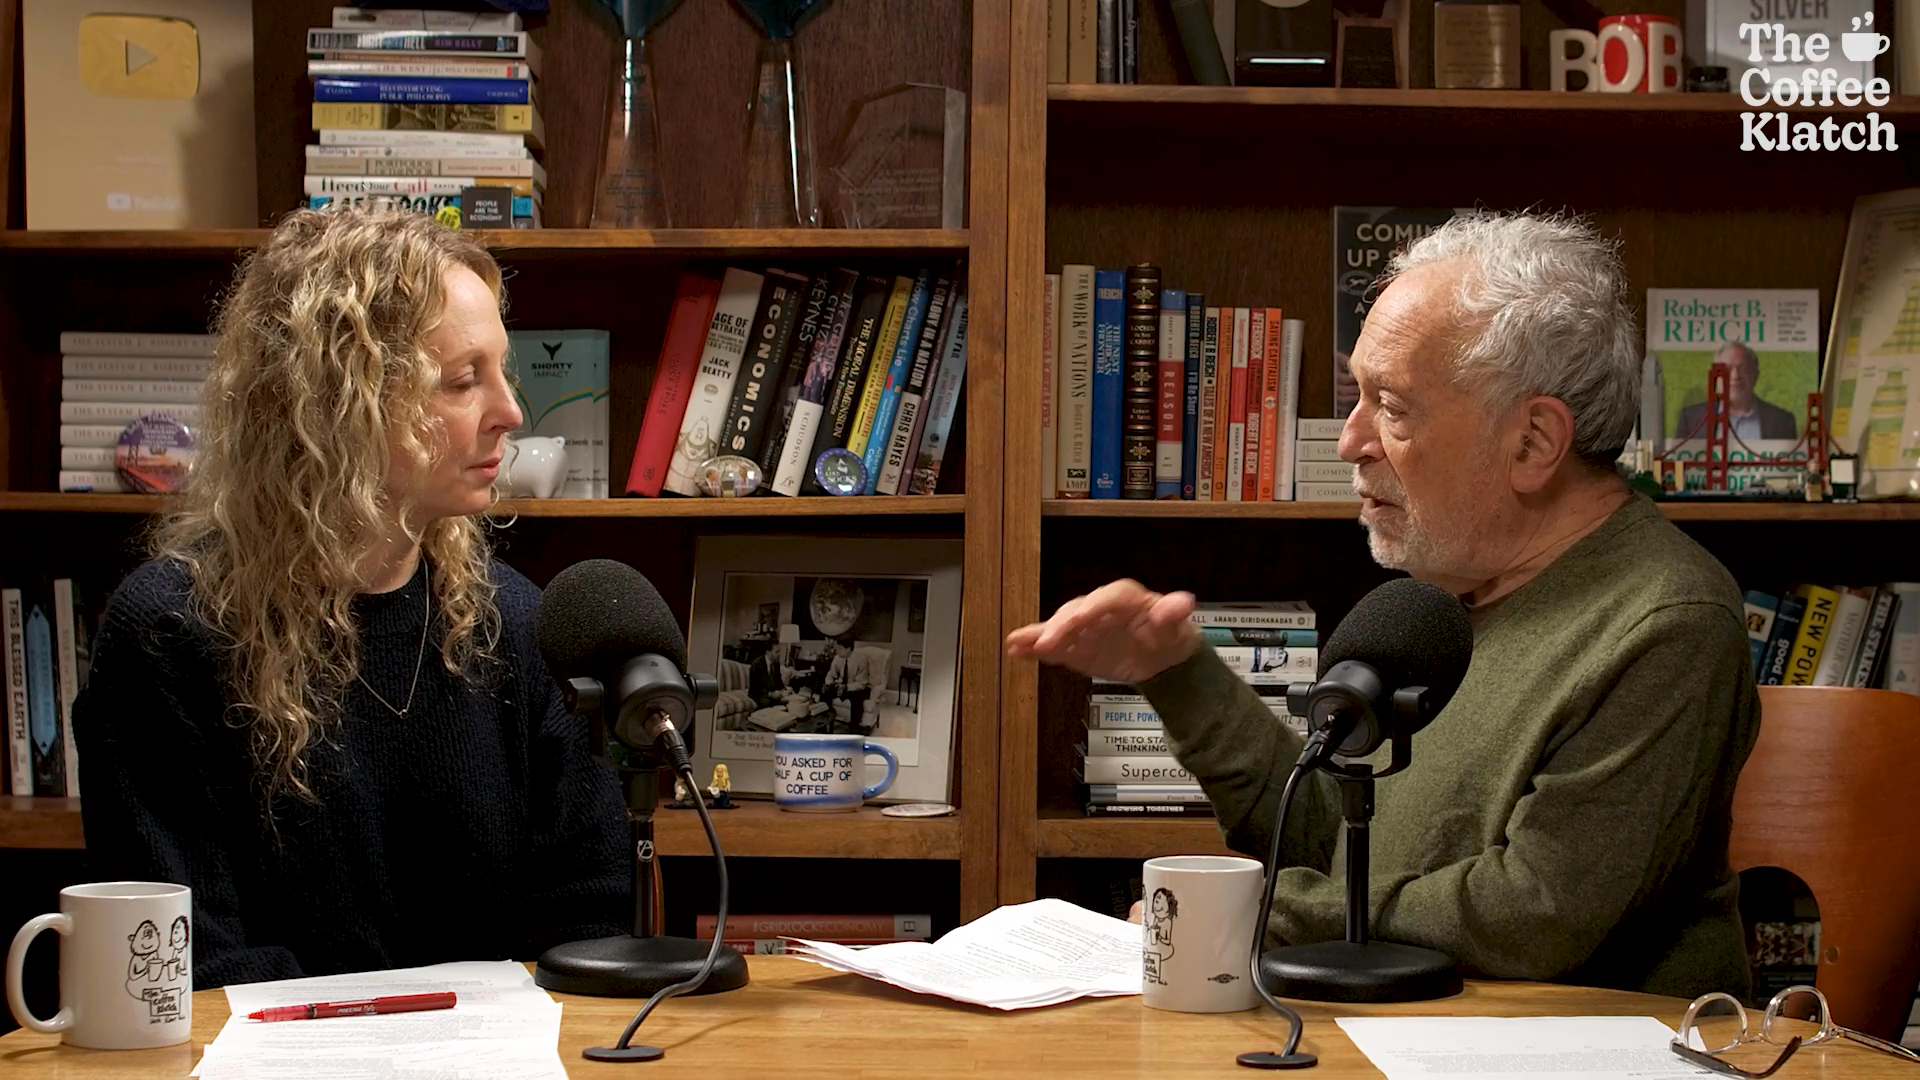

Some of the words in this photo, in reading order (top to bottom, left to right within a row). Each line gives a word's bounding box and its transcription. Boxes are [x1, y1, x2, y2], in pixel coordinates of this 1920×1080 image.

[400, 65, 426, 73] WEST
[1550, 23, 1683, 93] BOB
[1346, 249, 1380, 267] UP
[909, 273, 927, 305] How
[936, 276, 950, 287] A
[1077, 272, 1089, 291] THE
[1098, 288, 1123, 299] REICH
[799, 276, 830, 344] KEYNES
[836, 292, 853, 318] The
[925, 286, 947, 327] COLONY
[1071, 291, 1089, 329] WORK
[1664, 299, 1740, 319] Robert
[1746, 299, 1767, 318] B.
[711, 321, 746, 338] BETRAYAL
[714, 312, 732, 325] AGE
[734, 315, 749, 328] OF
[811, 293, 839, 363] CITIZEN
[858, 316, 875, 341] THE
[897, 304, 919, 349] Charts
[921, 325, 937, 340] IN
[1130, 324, 1156, 332] LOCKED
[1205, 315, 1217, 345] ROBERT
[1664, 320, 1766, 343] REICH
[919, 338, 933, 349] A
[1077, 329, 1088, 340] OF
[1111, 323, 1121, 346] THE
[1268, 319, 1280, 347] SAVING
[847, 339, 868, 379] MORAL
[892, 347, 907, 368] Lie
[1101, 322, 1114, 375] AMERICAN
[1109, 344, 1121, 375] NEXT
[98, 362, 135, 370] SYSTEM
[531, 362, 573, 370] SHORTY
[702, 364, 732, 380] BEATTY
[708, 356, 730, 369] JACK
[730, 284, 787, 451] ECONOMICS
[910, 348, 931, 388] NATION
[1068, 341, 1089, 398] NATIONS
[1203, 354, 1216, 378] REICH
[1265, 347, 1278, 392] CAPITALISM
[831, 377, 857, 439] DIMENSION
[1160, 370, 1175, 431] REASON
[1202, 385, 1214, 410] TALES
[896, 400, 916, 433] CHRIS
[1201, 409, 1213, 421] OF
[1246, 411, 1260, 442] ROBERT
[789, 409, 810, 467] SCHUDSON
[887, 433, 907, 467] HAYES
[1199, 444, 1212, 481] AMERICA
[1244, 450, 1258, 474] REICH
[1663, 449, 1808, 473] ECOOMICS
[1065, 479, 1088, 489] KNOPF
[8, 599, 20, 628] THIS
[1240, 616, 1293, 624] GIRIDHARADAS
[1804, 596, 1833, 641] NEW
[1870, 592, 1893, 630] THE
[10, 632, 23, 687] BLESSED
[12, 690, 26, 740] EARTH
[1104, 736, 1129, 744] TIME
[1130, 736, 1145, 744] TO
[1115, 744, 1167, 752] THINKING
[775, 757, 788, 768] YOU
[791, 758, 826, 768] ASKED
[833, 758, 853, 768] FOR
[796, 770, 804, 780] A
[810, 771, 833, 781] CUP
[839, 770, 853, 780] OF
[786, 784, 828, 795] COFFEE
